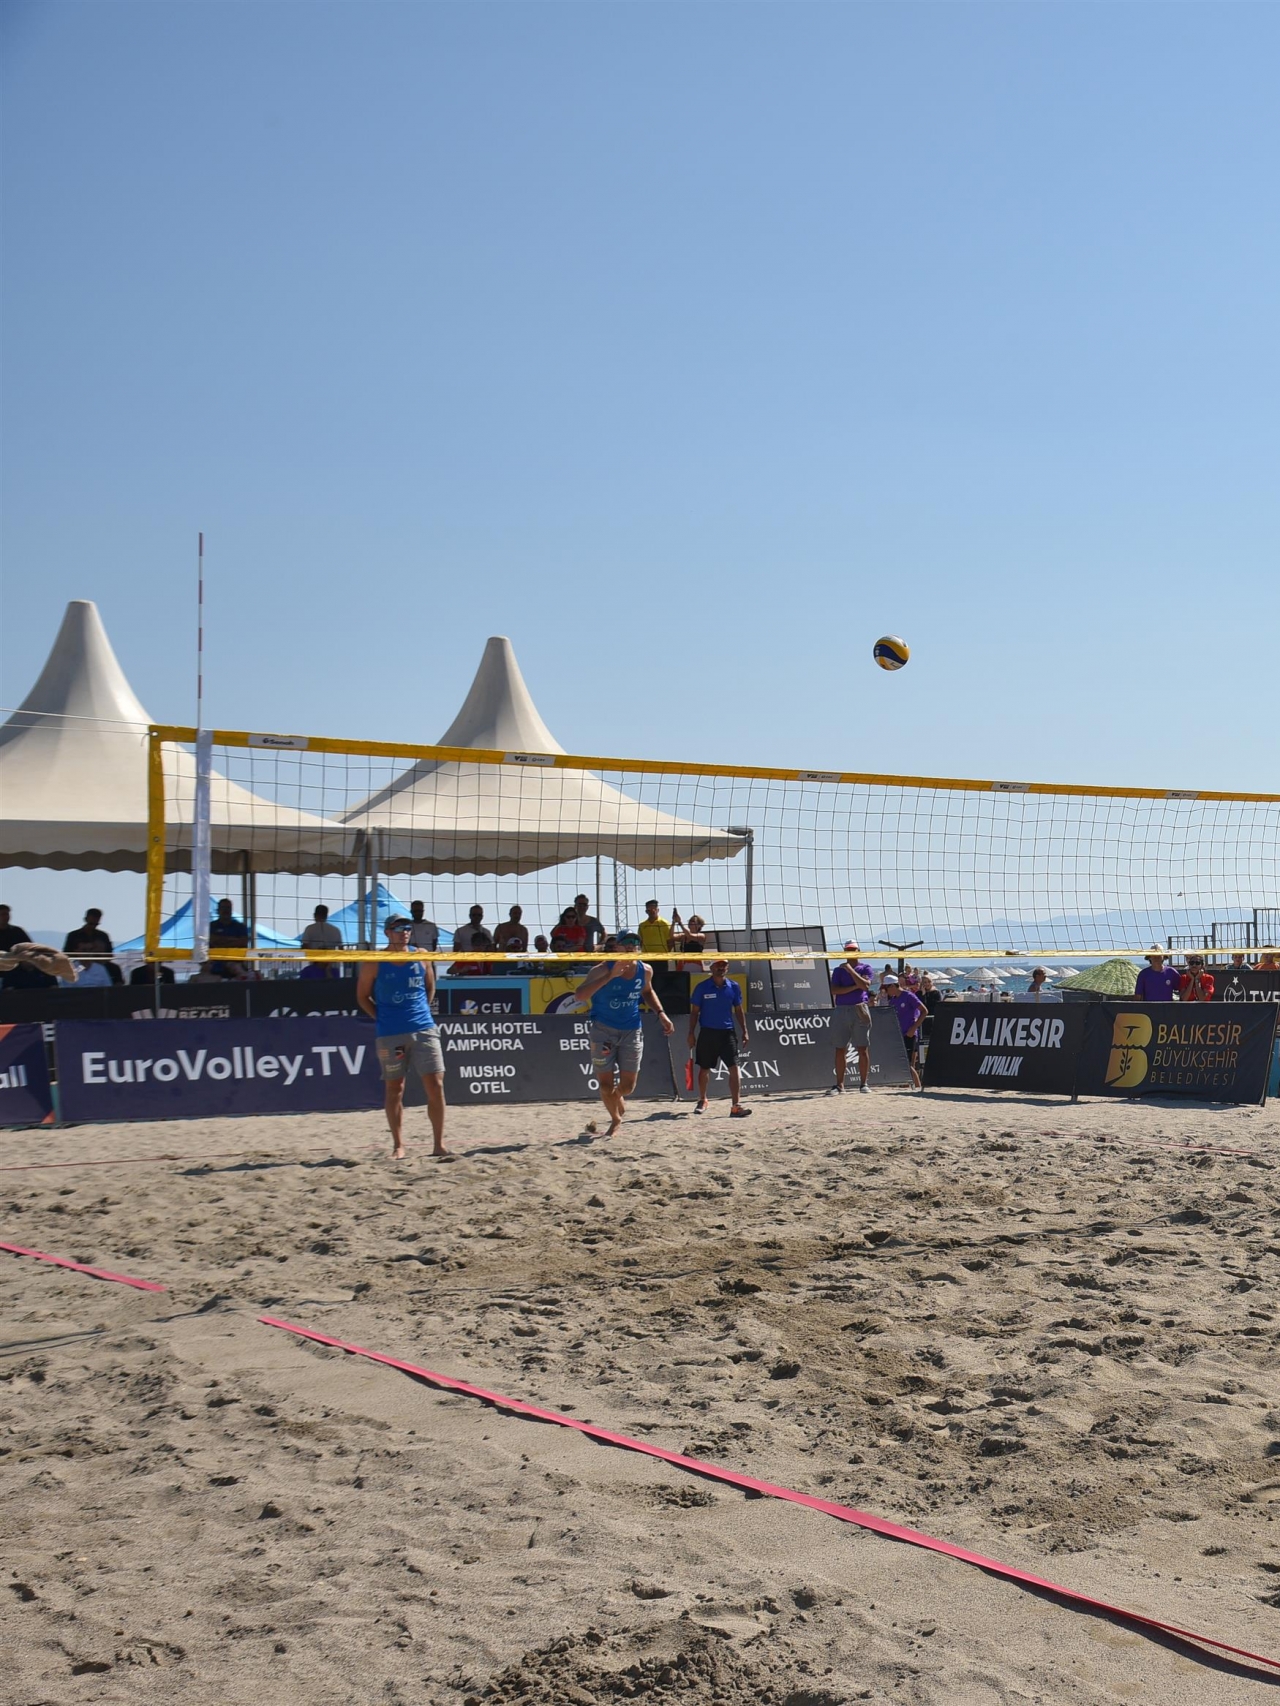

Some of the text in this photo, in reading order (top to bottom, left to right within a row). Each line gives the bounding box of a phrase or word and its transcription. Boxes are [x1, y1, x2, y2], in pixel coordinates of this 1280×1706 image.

[410, 962, 420, 975] 1
[634, 978, 642, 989] 2
[481, 1002, 512, 1013] CEV
[435, 1021, 542, 1036] YVALIK HOTEL
[754, 1015, 832, 1032] KÜÇÜKKÖY
[778, 1033, 816, 1047] OTEL
[949, 1017, 1065, 1049] BALIKESIR
[1157, 1020, 1242, 1046] BALIKESİR
[446, 1038, 525, 1052] AMPHORA
[559, 1039, 591, 1052] BER
[81, 1045, 366, 1086] EuroVolley.TV
[977, 1055, 1025, 1077] AYVALIK
[1152, 1048, 1239, 1072] BÜYÜKŞEHİR
[459, 1065, 516, 1079] MUSHO
[869, 1064, 880, 1074] 87
[1150, 1070, 1237, 1087] BELEDİYESİ
[469, 1081, 511, 1095] OTEL
